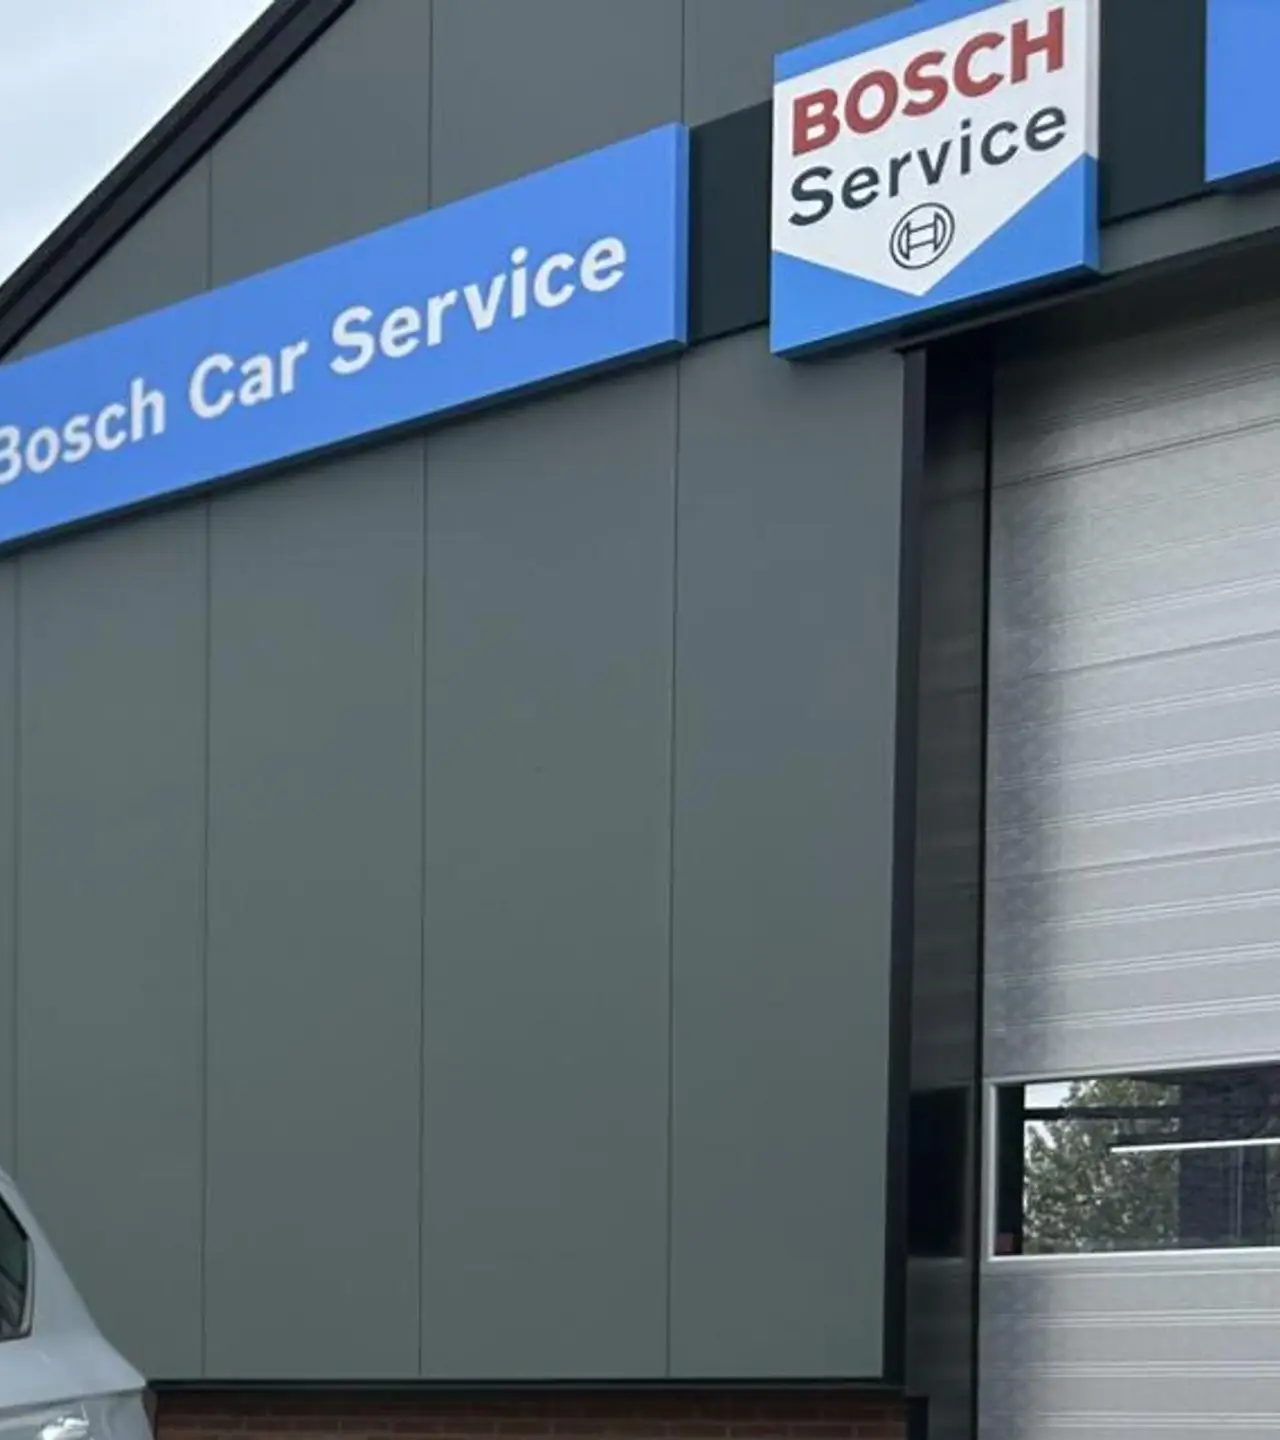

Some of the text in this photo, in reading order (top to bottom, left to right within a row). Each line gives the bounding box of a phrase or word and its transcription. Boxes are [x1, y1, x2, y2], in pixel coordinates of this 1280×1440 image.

[792, 7, 1065, 156] BOSCH
[789, 106, 1067, 227] Service
[187, 337, 310, 419] Car
[328, 235, 628, 376] Service
